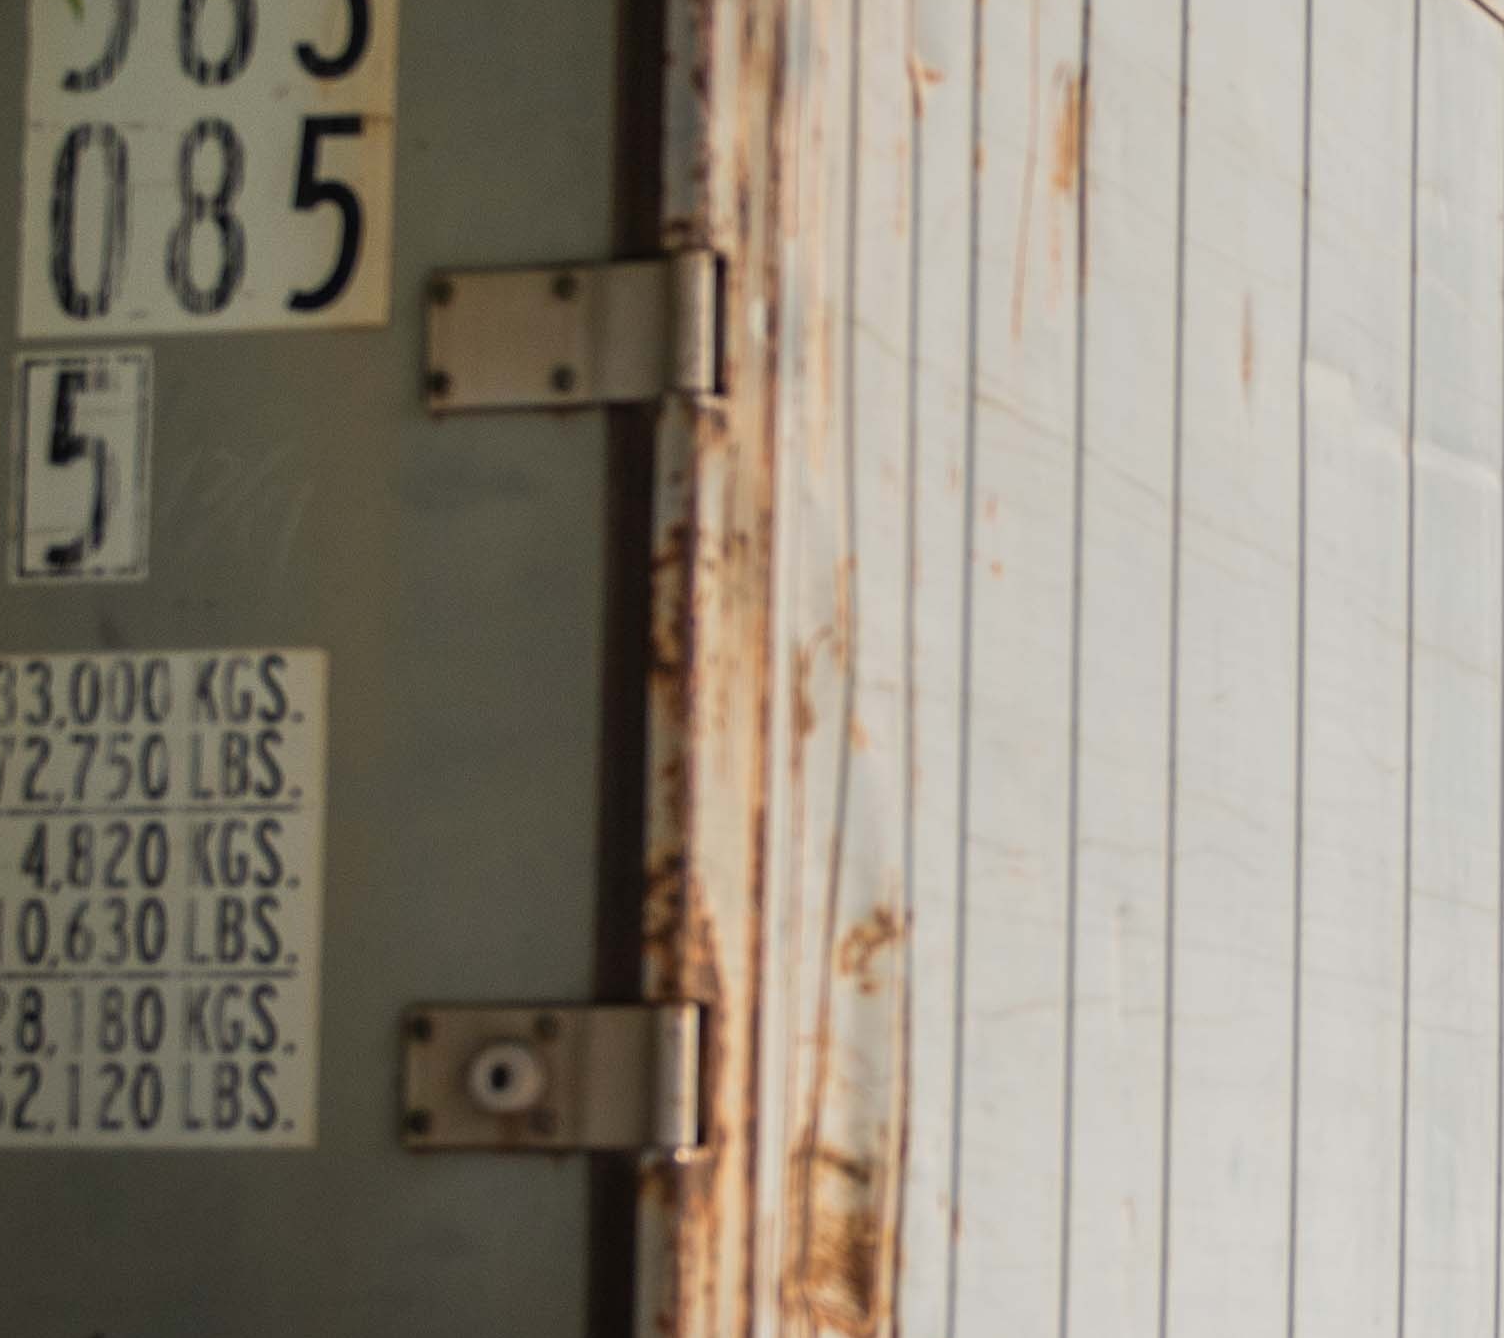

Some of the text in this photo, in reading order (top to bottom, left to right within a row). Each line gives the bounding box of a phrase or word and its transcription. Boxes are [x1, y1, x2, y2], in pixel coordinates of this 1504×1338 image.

[49, 114, 367, 320] 085
[43, 370, 120, 567] 5
[193, 654, 303, 724] KGS.
[191, 728, 302, 800] LBS.
[191, 818, 300, 890] KGS.
[185, 895, 299, 965] LBS.
[185, 982, 295, 1055] KGS.
[180, 1061, 294, 1132] LBS.
